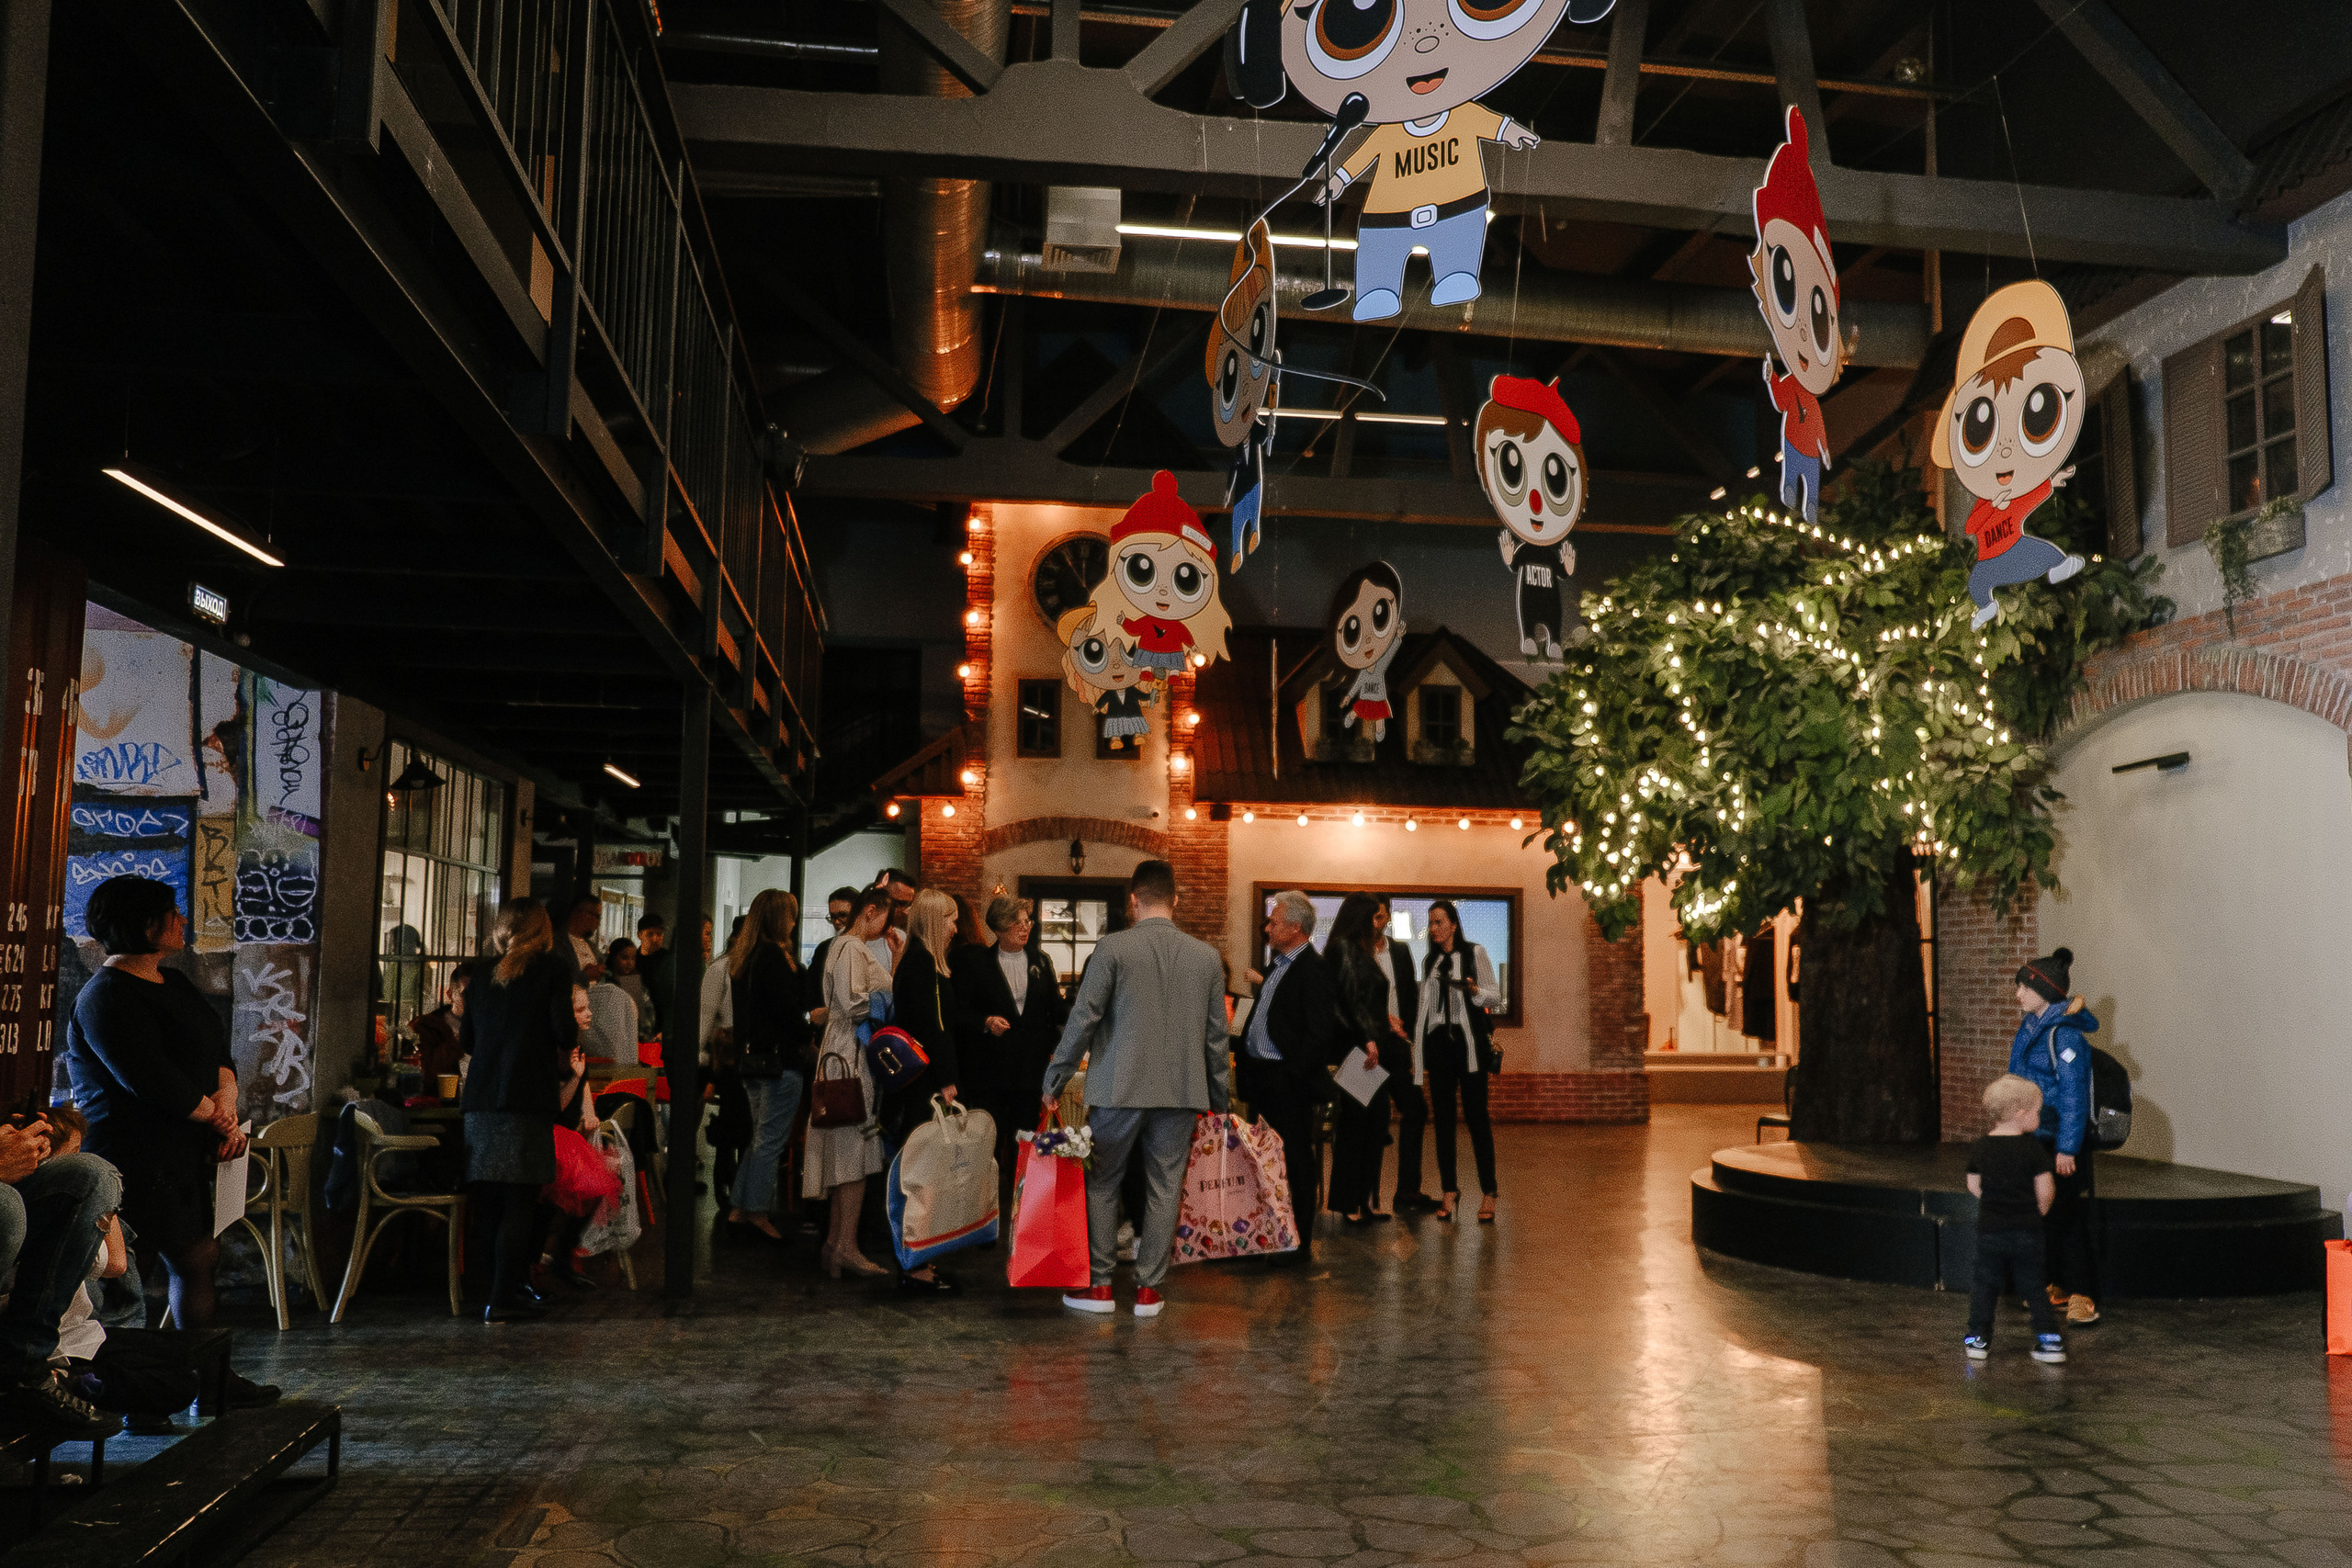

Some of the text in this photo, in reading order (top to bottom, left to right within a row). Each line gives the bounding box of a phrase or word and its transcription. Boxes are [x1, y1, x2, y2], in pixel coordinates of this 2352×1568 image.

[1395, 137, 1459, 179] MUSIC
[1984, 516, 2014, 548] DANCE
[1525, 564, 1553, 588] ACTOR
[194, 588, 224, 618] ВЫХОД
